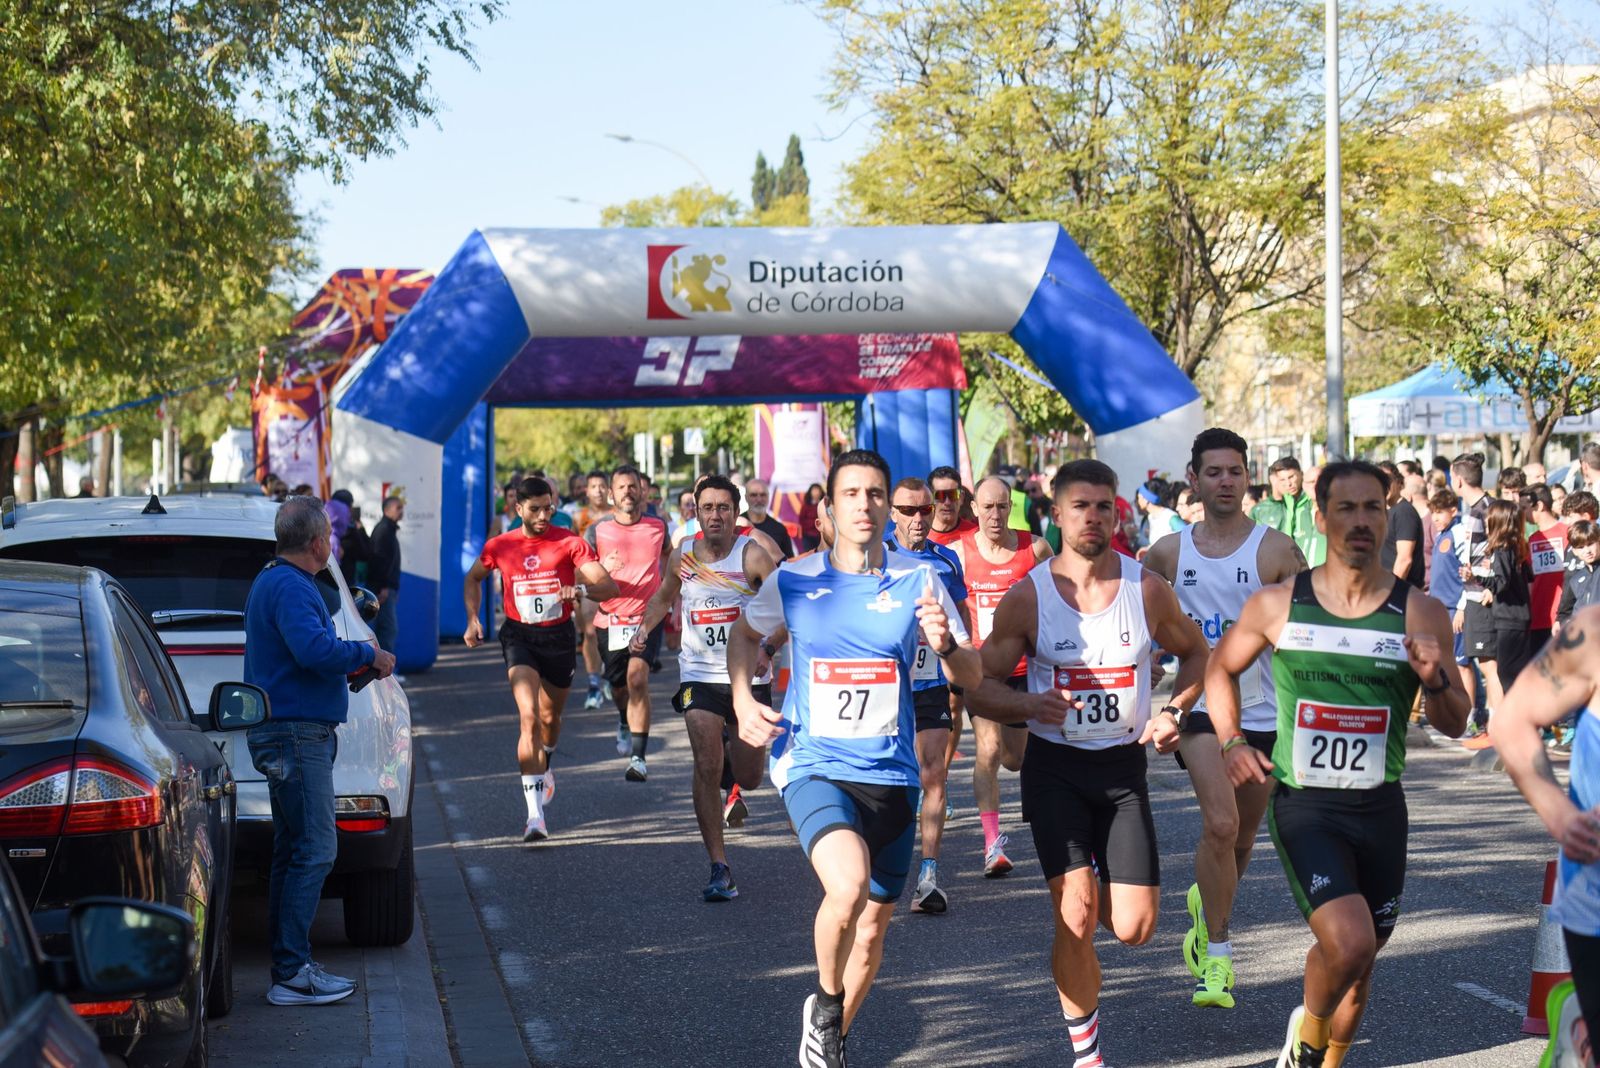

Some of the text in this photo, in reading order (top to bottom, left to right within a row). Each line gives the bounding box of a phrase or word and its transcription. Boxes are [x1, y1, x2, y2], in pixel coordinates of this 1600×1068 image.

[748, 259, 903, 288] Diputación
[747, 291, 904, 313] de Córdoba
[1538, 552, 1556, 567] 135
[534, 597, 544, 614] 6
[705, 625, 728, 647] 34
[838, 689, 870, 720] 27
[1075, 693, 1120, 725] 138
[1310, 735, 1368, 771] 202
